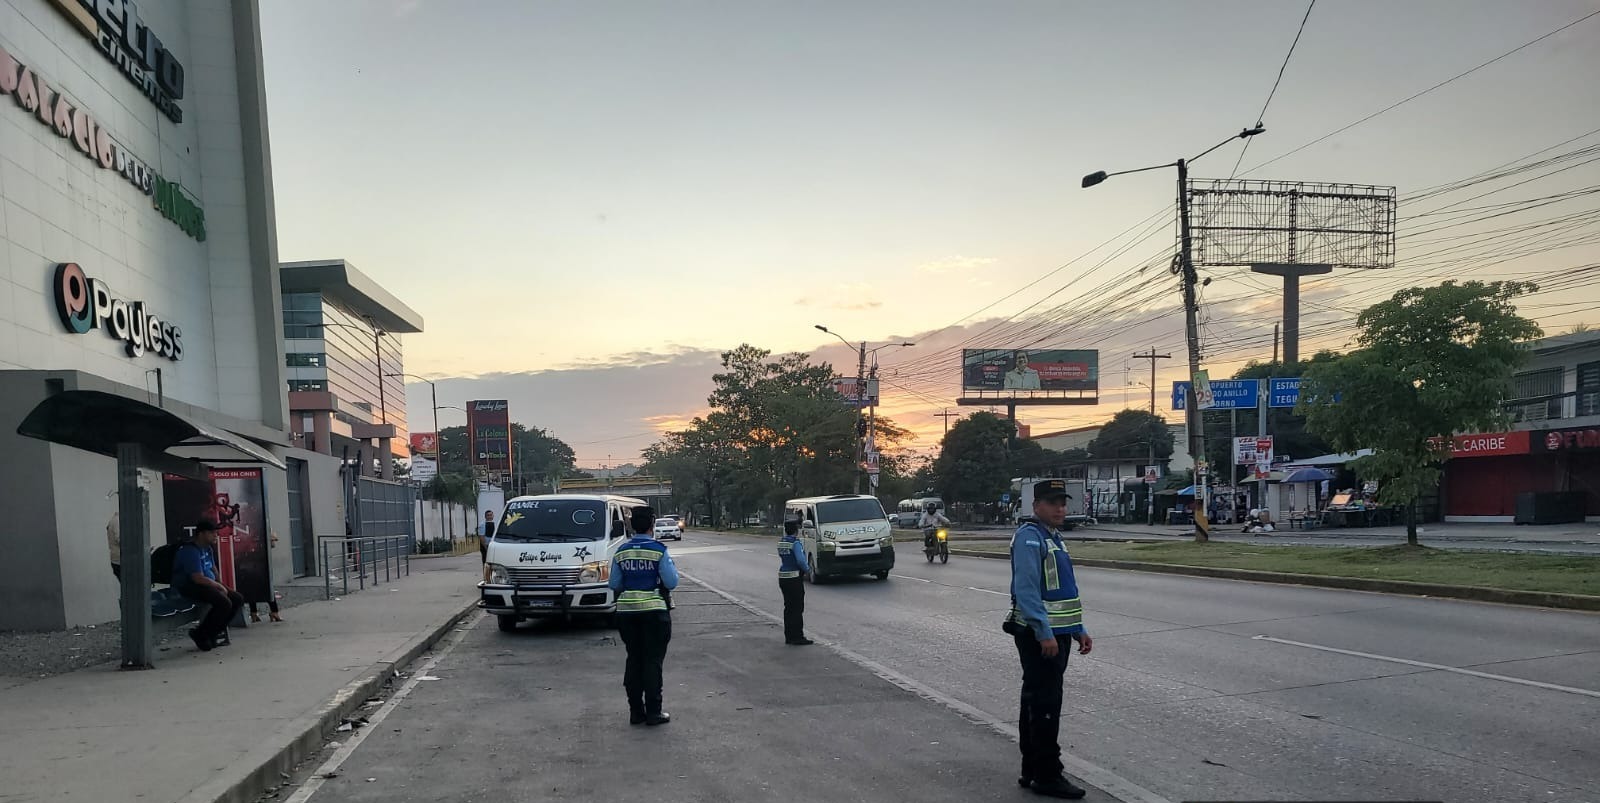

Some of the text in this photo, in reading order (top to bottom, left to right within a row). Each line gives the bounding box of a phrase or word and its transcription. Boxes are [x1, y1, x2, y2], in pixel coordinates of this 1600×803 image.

[86, 0, 184, 100] etro
[96, 29, 183, 123] cinemas
[91, 277, 184, 361] Payless
[1211, 381, 1243, 389] OPUERTO
[1223, 389, 1248, 397] ANILLO
[1463, 437, 1506, 451] CARIBE
[509, 501, 540, 510] DANIEL
[620, 559, 655, 571] POLICIA
